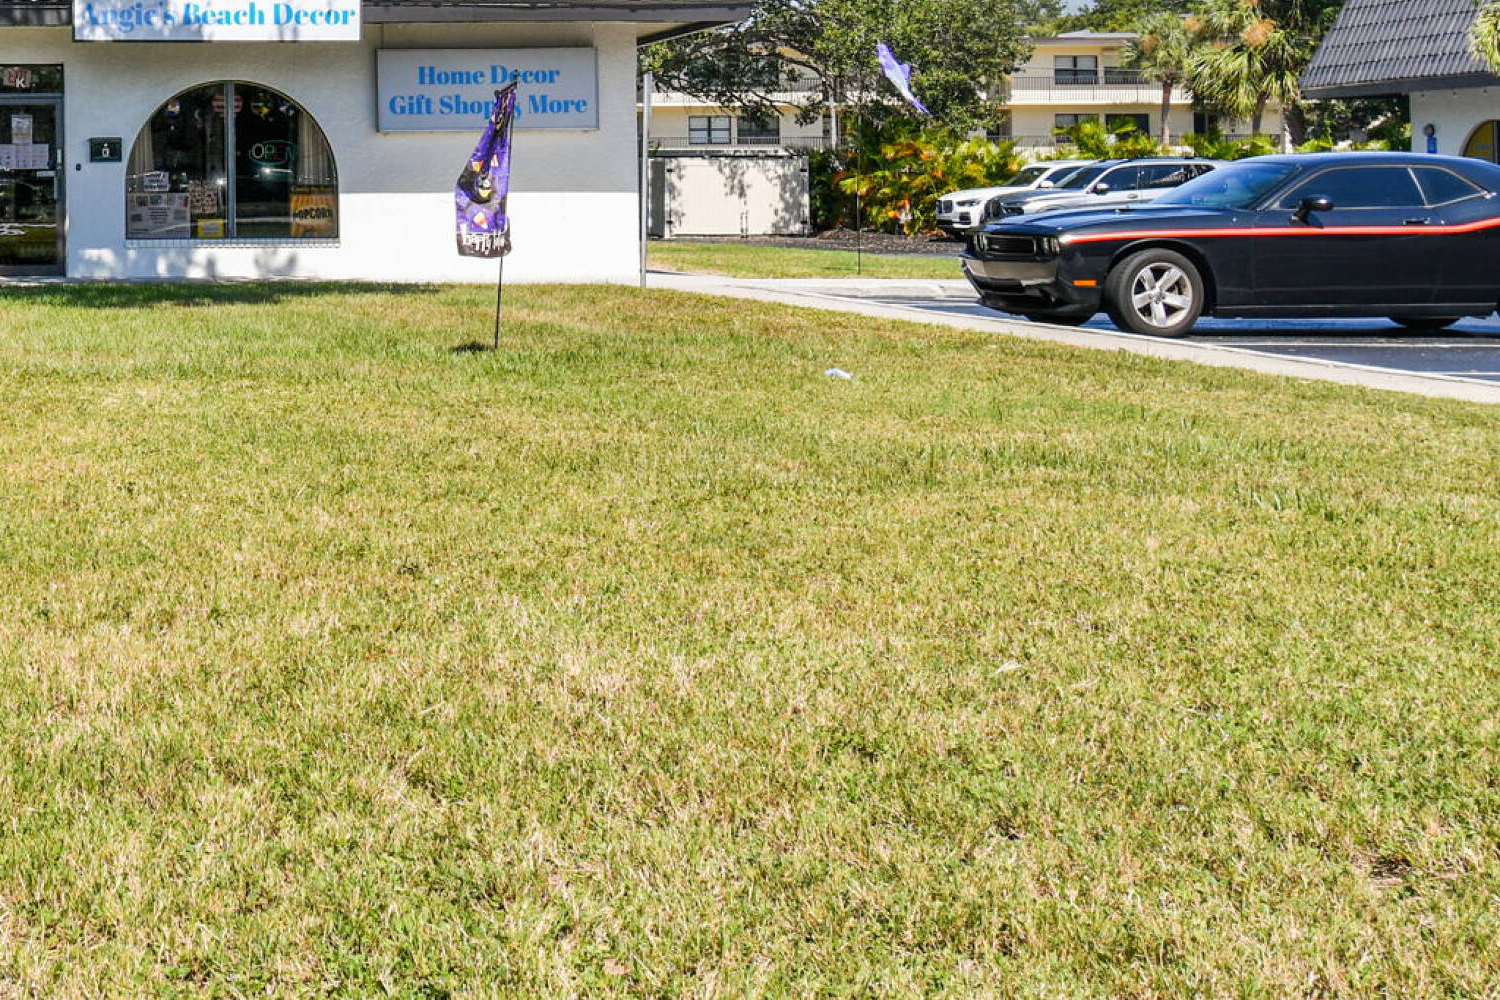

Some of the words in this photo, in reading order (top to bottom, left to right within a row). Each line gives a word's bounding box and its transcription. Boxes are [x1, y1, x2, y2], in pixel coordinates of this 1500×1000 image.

[84, 2, 175, 33] Angie's
[182, 2, 265, 25] Beach
[273, 2, 356, 25] Decor
[15, 76, 26, 88] K
[418, 66, 485, 85] Home
[490, 65, 561, 84] Decor
[389, 94, 433, 115] Gift
[528, 94, 588, 114] More
